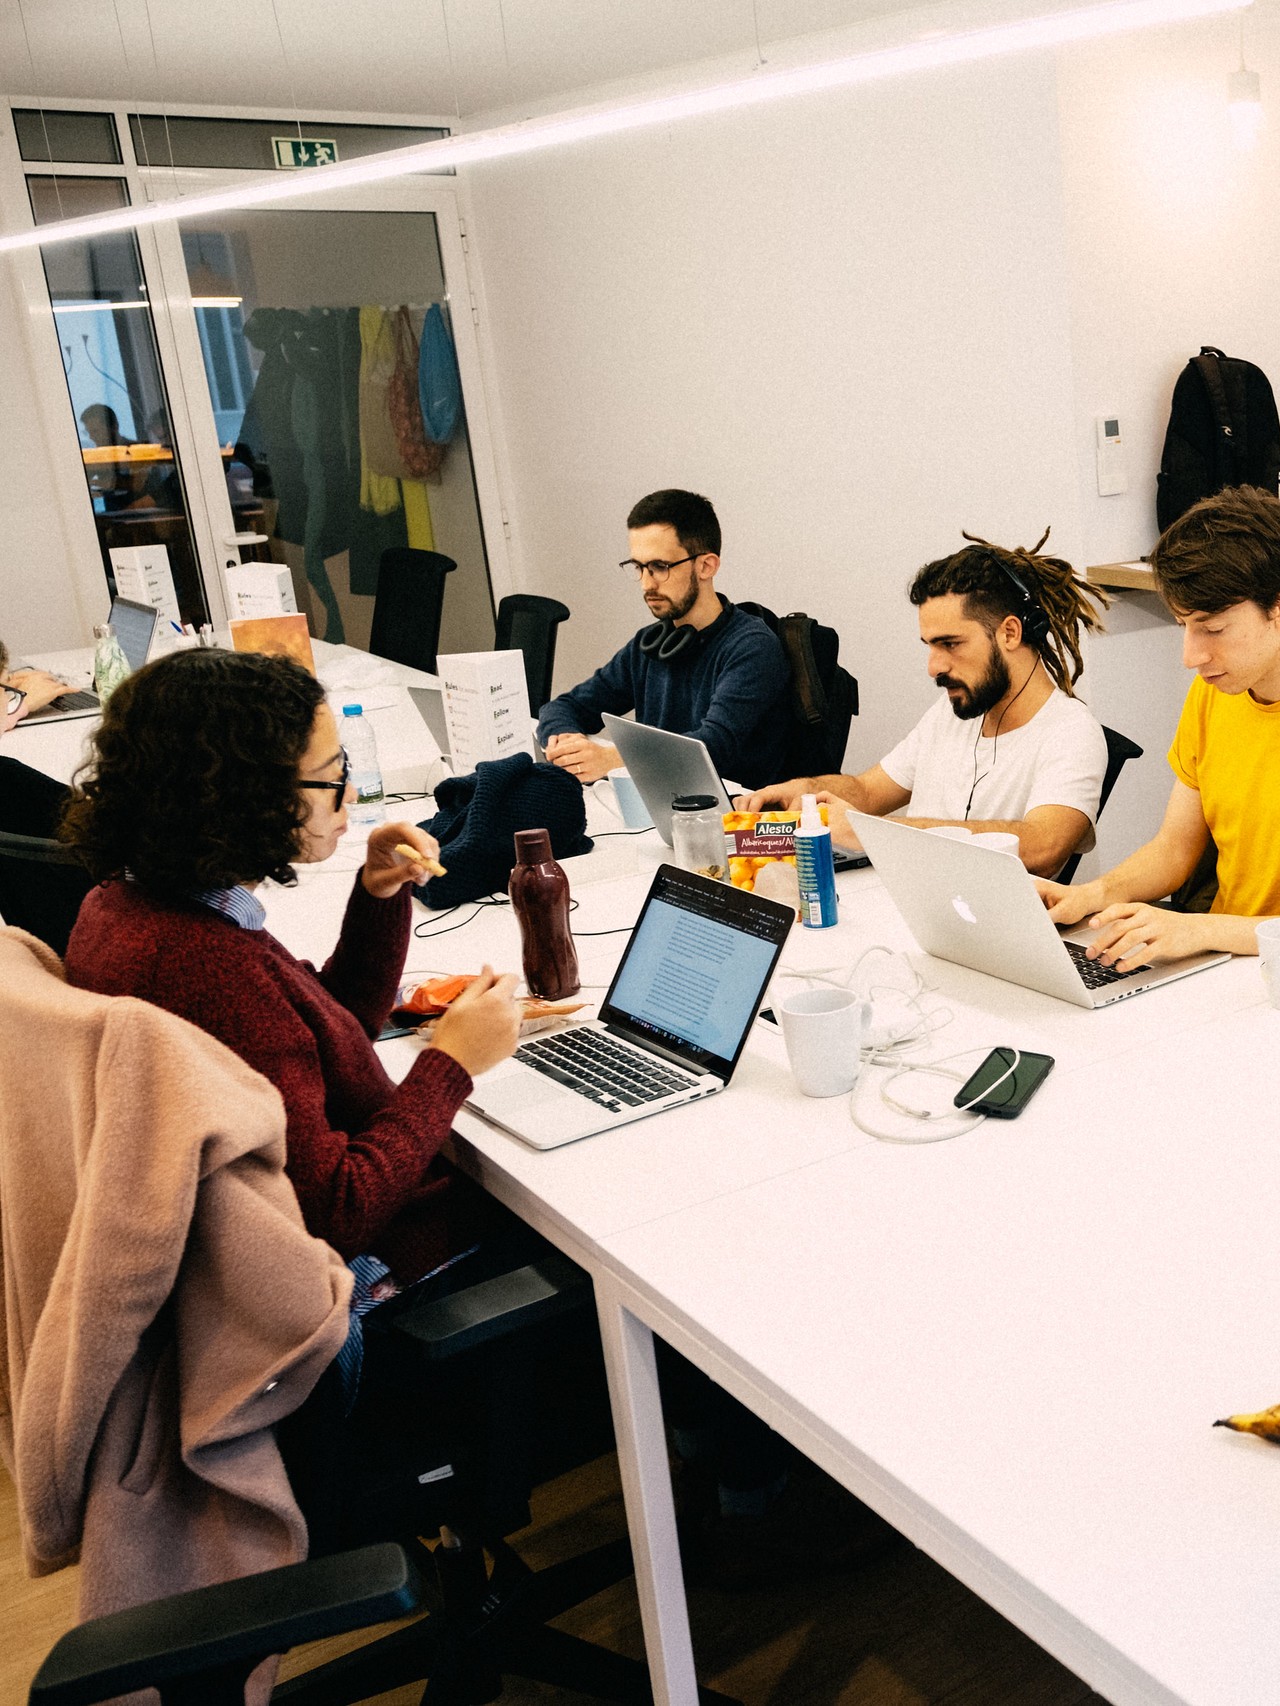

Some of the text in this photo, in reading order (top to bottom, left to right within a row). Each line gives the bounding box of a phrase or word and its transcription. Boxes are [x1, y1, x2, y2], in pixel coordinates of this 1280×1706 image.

[445, 681, 458, 691] Rules
[490, 683, 502, 693] Read
[494, 708, 509, 718] Follow
[497, 733, 513, 744] Explain
[758, 824, 793, 834] Alesto
